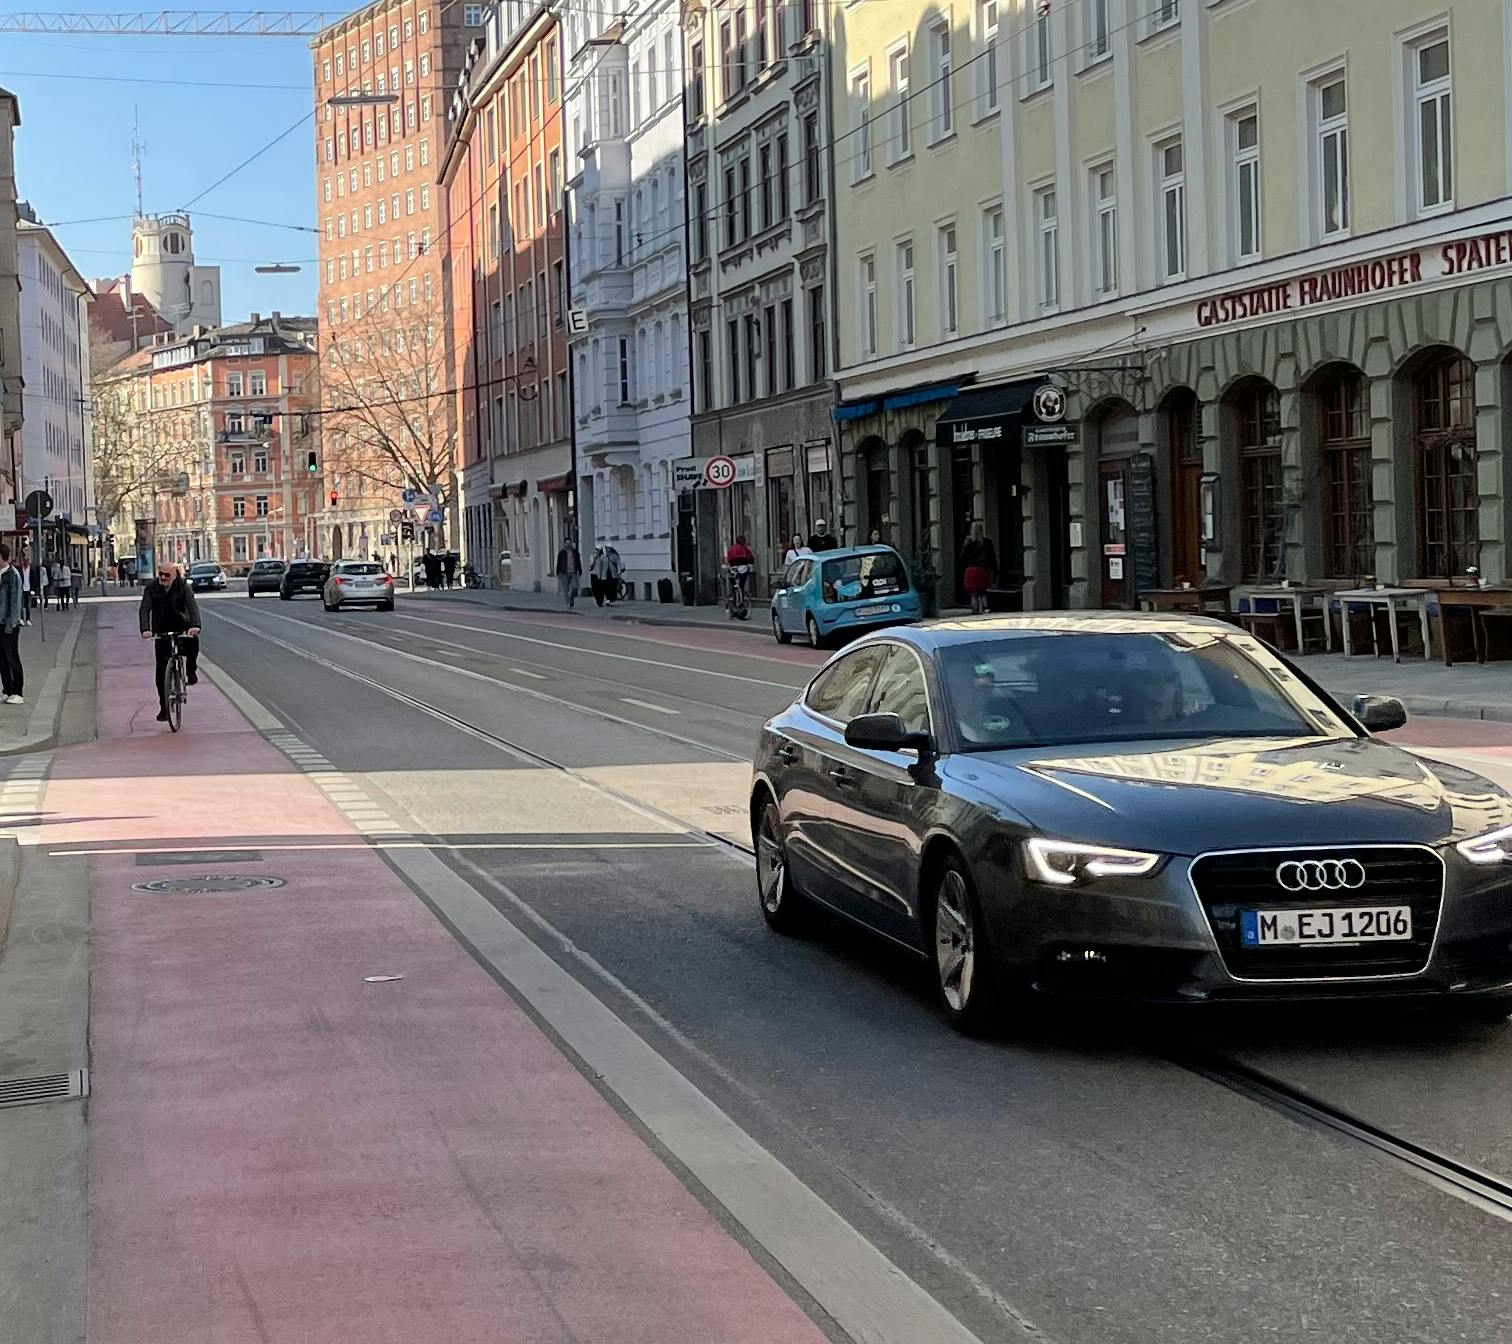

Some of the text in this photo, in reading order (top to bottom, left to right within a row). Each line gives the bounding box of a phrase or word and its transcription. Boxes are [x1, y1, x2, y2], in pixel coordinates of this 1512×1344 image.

[1299, 252, 1422, 306] FRAUNHOFER
[1441, 231, 1512, 276] SPATE
[571, 310, 586, 330] E
[711, 464, 730, 479] 30
[1260, 909, 1408, 940] M EJ 1206
